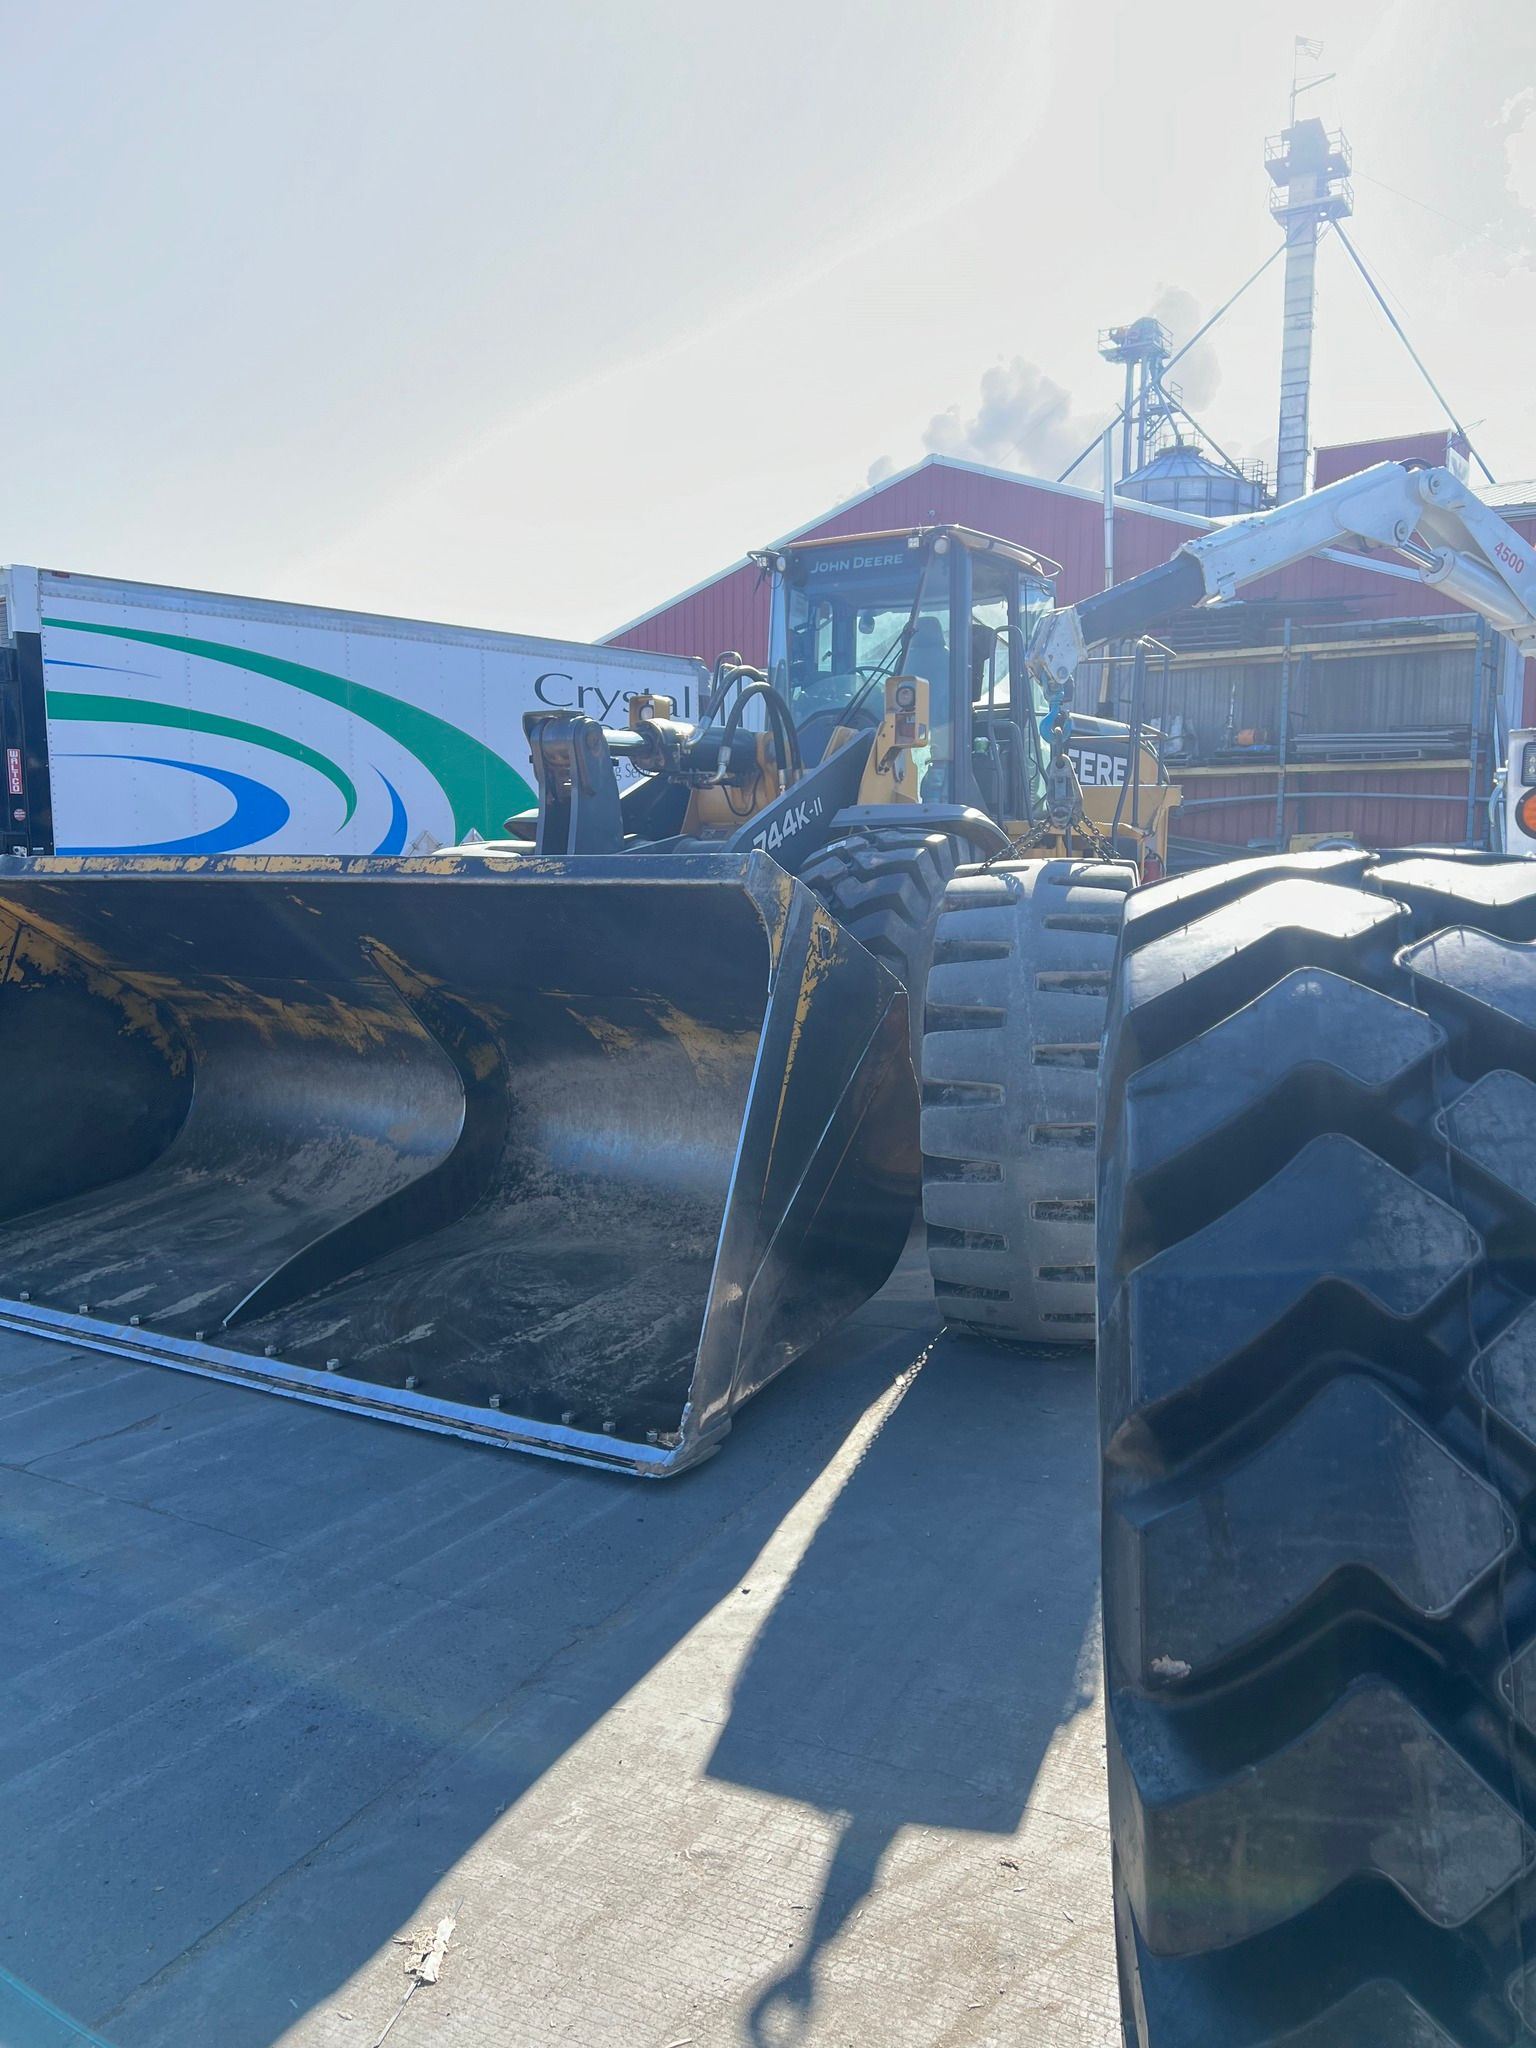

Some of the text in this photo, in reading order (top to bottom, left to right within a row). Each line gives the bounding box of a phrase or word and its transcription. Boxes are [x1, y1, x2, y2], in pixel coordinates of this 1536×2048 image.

[810, 553, 904, 574] JOHN DEERE
[1494, 541, 1525, 574] 4500
[534, 673, 690, 721] Crysal
[10, 750, 20, 792] WALTCO
